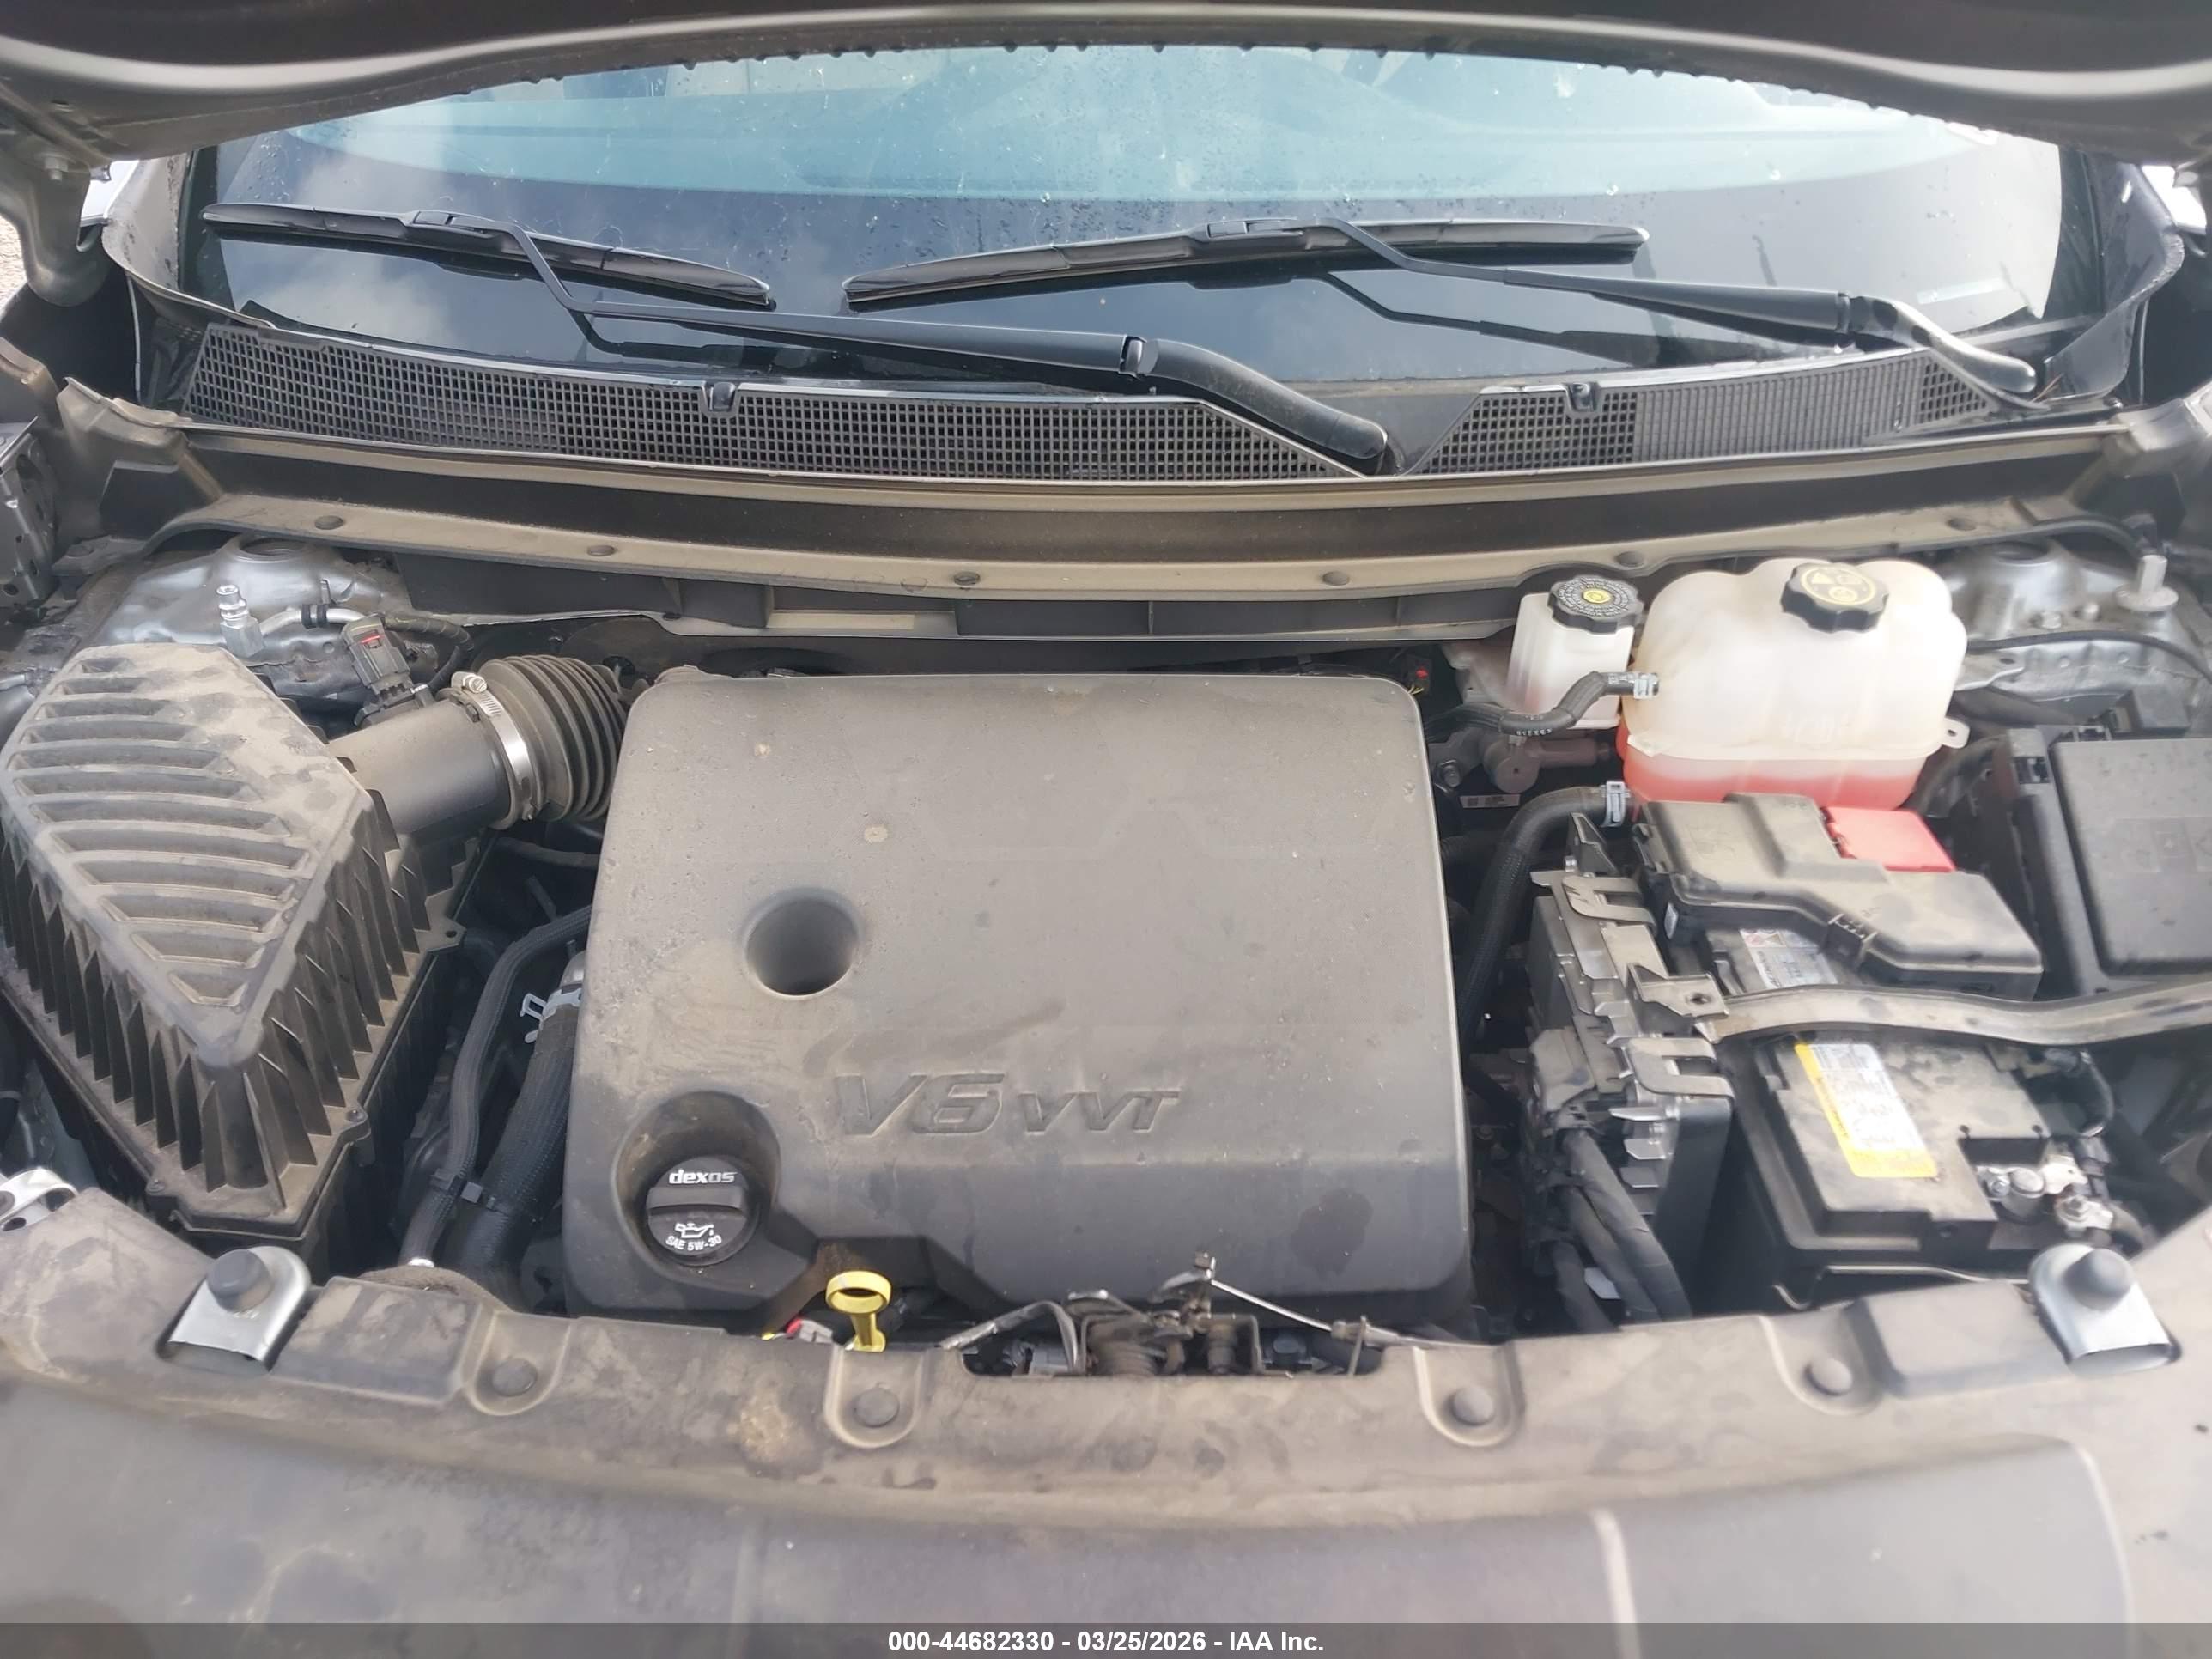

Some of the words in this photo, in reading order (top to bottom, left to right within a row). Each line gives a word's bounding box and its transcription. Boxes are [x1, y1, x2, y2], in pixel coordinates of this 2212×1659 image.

[835, 1071, 1006, 1137] V6
[1019, 1089, 1180, 1134] VVT
[669, 1169, 738, 1184] dexos
[666, 1236, 686, 1250] SAE
[687, 1234, 722, 1251] 5W-30
